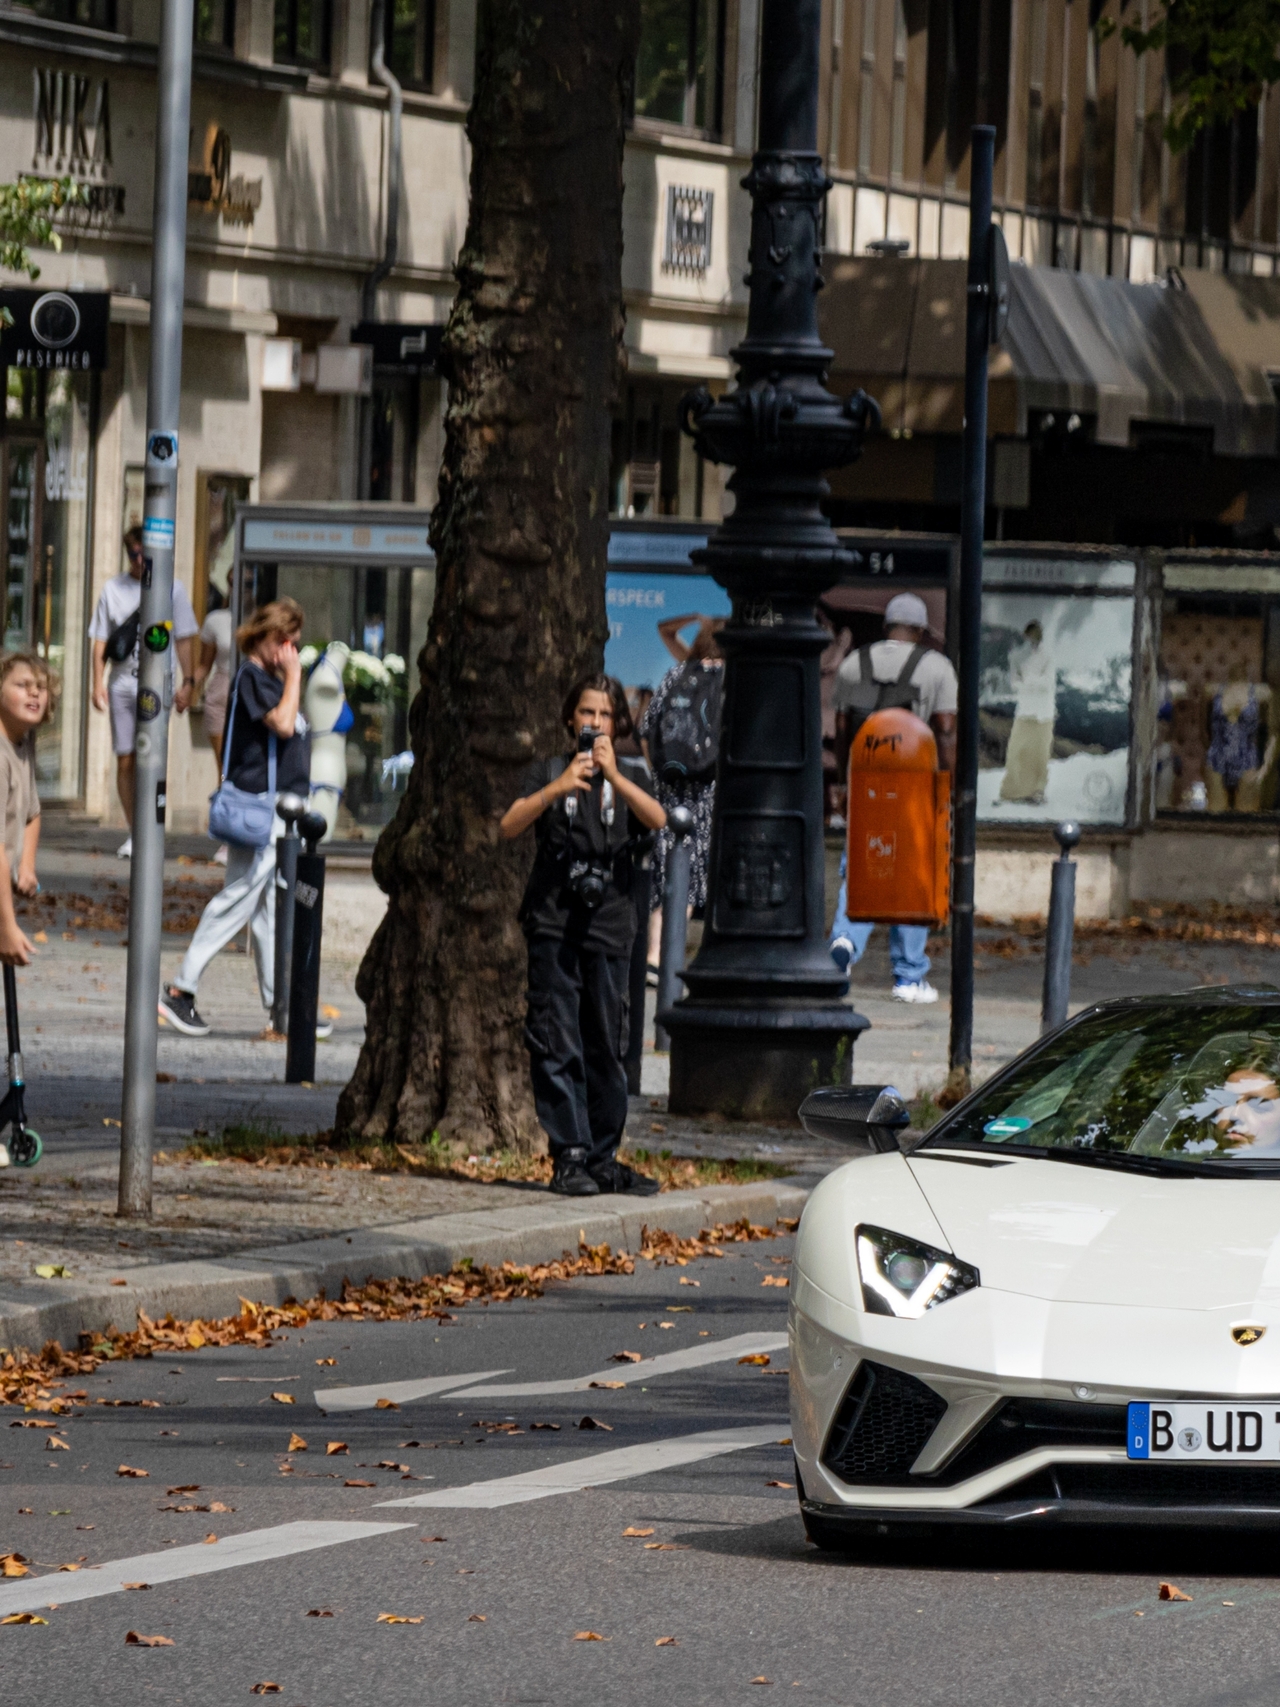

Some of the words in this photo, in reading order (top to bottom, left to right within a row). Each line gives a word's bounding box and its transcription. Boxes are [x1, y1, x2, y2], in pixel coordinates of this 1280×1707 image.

[1134, 1436, 1143, 1449] D
[1151, 1410, 1174, 1452] B
[1207, 1410, 1263, 1453] UD
